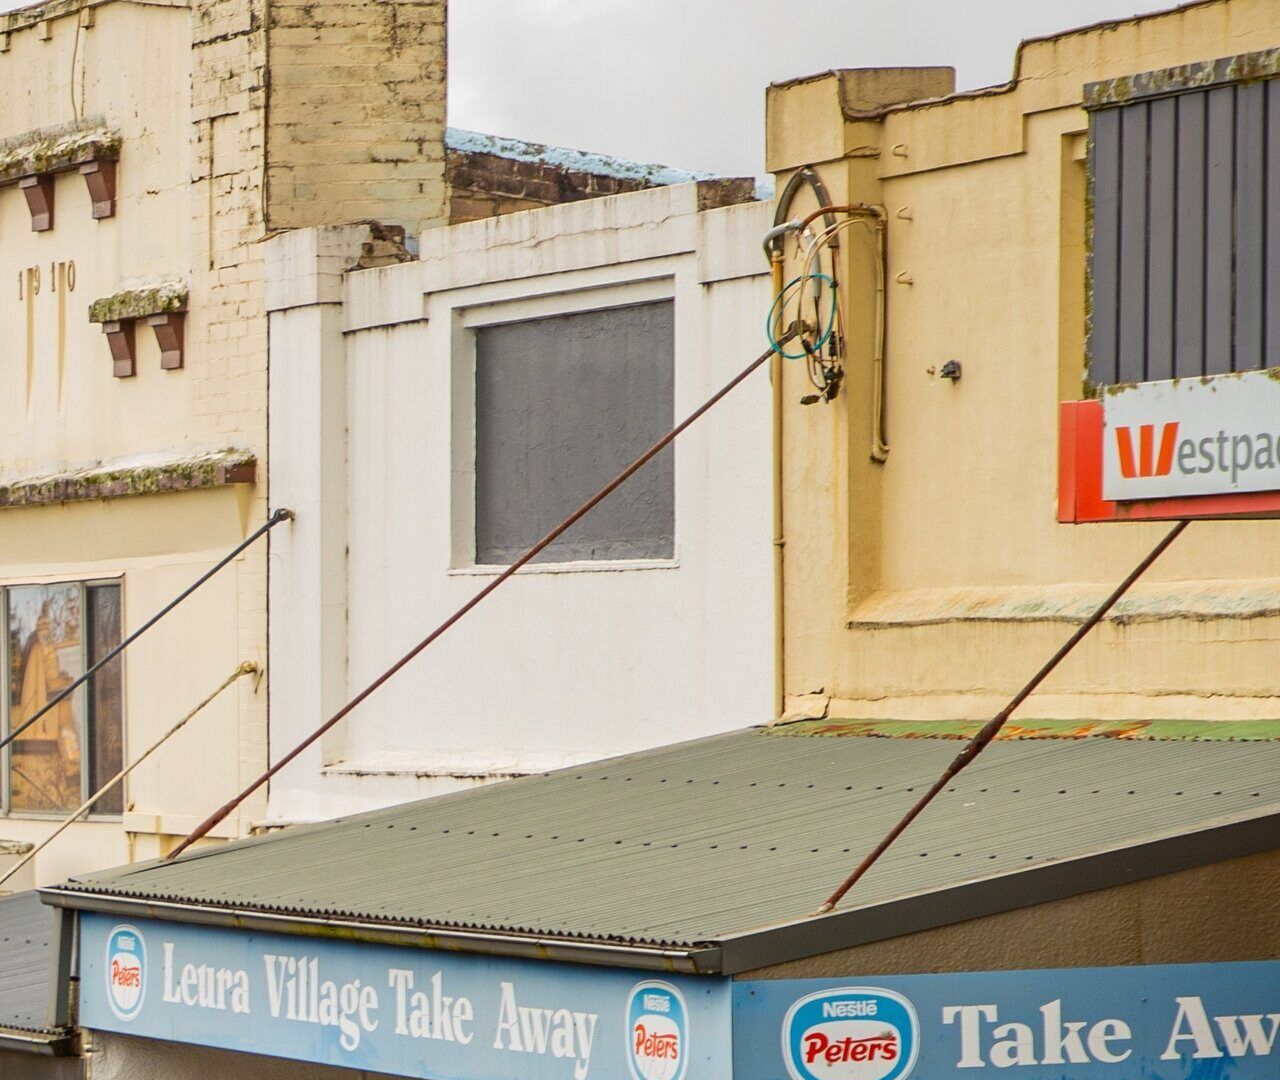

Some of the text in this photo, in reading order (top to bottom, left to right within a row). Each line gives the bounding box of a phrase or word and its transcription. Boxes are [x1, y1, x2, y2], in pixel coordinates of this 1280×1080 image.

[1115, 420, 1280, 484] Westpa
[111, 957, 141, 990] Peters
[162, 942, 251, 1015] Leura
[263, 953, 379, 1052] Village
[388, 966, 474, 1044] Take
[634, 1023, 679, 1060] Peters
[804, 1031, 897, 1065] Peters
[941, 998, 1133, 1069] Take
